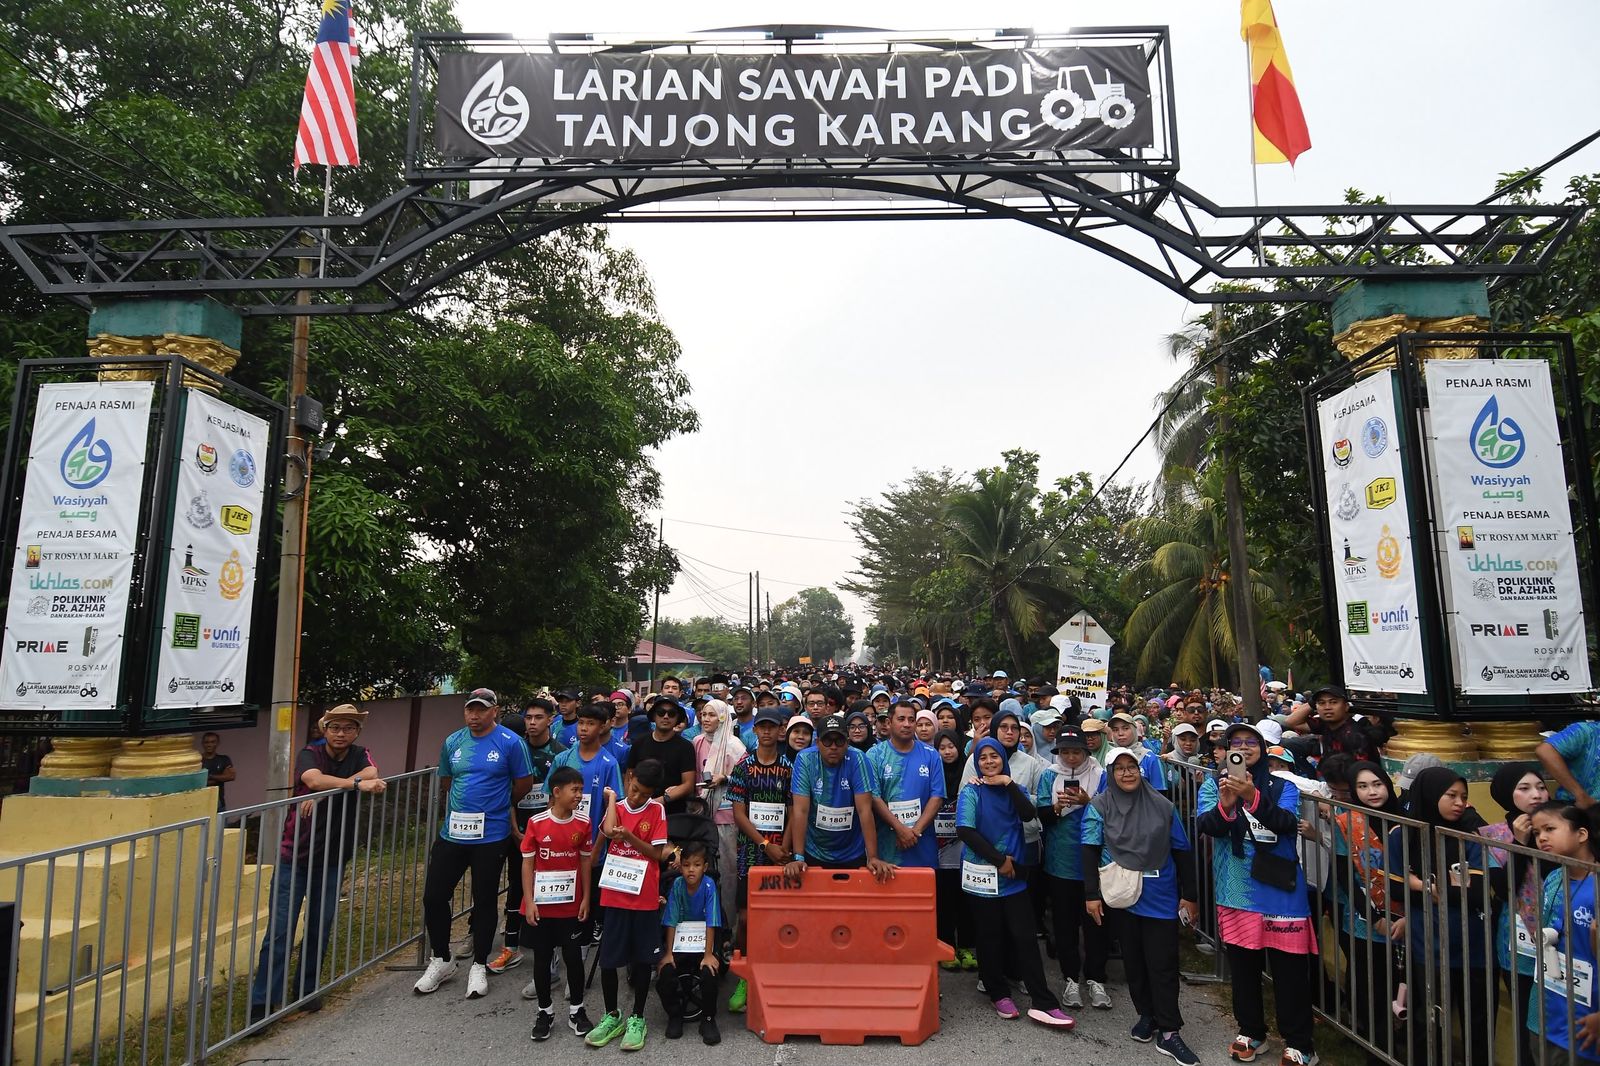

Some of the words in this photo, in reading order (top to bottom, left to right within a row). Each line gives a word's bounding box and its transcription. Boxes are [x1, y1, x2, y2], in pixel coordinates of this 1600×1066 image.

[552, 65, 723, 102] LARIAN
[738, 65, 905, 101] SAWAH
[924, 64, 1033, 98] PADI
[556, 112, 795, 148] TANJONG
[817, 108, 1031, 146] KARANG
[1446, 378, 1493, 388] PENAJA
[1496, 378, 1532, 388] RASMI
[55, 401, 96, 410] PENAJA
[99, 400, 135, 409] RASMI
[1333, 394, 1377, 420] KERJASAMA
[207, 414, 251, 439] KERJASAMA
[1471, 475, 1531, 487] Wasiyyah
[53, 495, 107, 507] Wasiyyah
[1463, 510, 1506, 519] PENAJA
[1507, 510, 1550, 519] BESAMA
[37, 530, 74, 539] PENAJA
[76, 530, 117, 538] BESAMA
[1475, 534, 1488, 542] ST
[1490, 533, 1529, 542] ROSYAM
[1531, 533, 1558, 541] MART
[42, 552, 53, 560] ST
[55, 552, 91, 560] ROSYAM
[1344, 565, 1367, 576] MPKS
[180, 575, 207, 588] MPKS
[1497, 577, 1553, 586] POLIKLINIK
[1498, 586, 1517, 595] DR.
[1519, 586, 1556, 595] AZHAR
[53, 595, 106, 604] POLIKLINIK
[51, 604, 68, 612] DR.
[71, 604, 106, 612] AZHAR
[1381, 605, 1409, 623] unifi
[213, 625, 240, 641] unifi
[1382, 624, 1409, 632] BUSINESS
[1534, 647, 1573, 655] ROSYAM
[1060, 676, 1104, 688] PANCURAN
[1066, 689, 1097, 699] BOMBA
[526, 793, 544, 801] 0359
[901, 811, 918, 820] 1804
[616, 871, 638, 882] 0482
[972, 875, 991, 884] 2541
[549, 884, 570, 892] 1797
